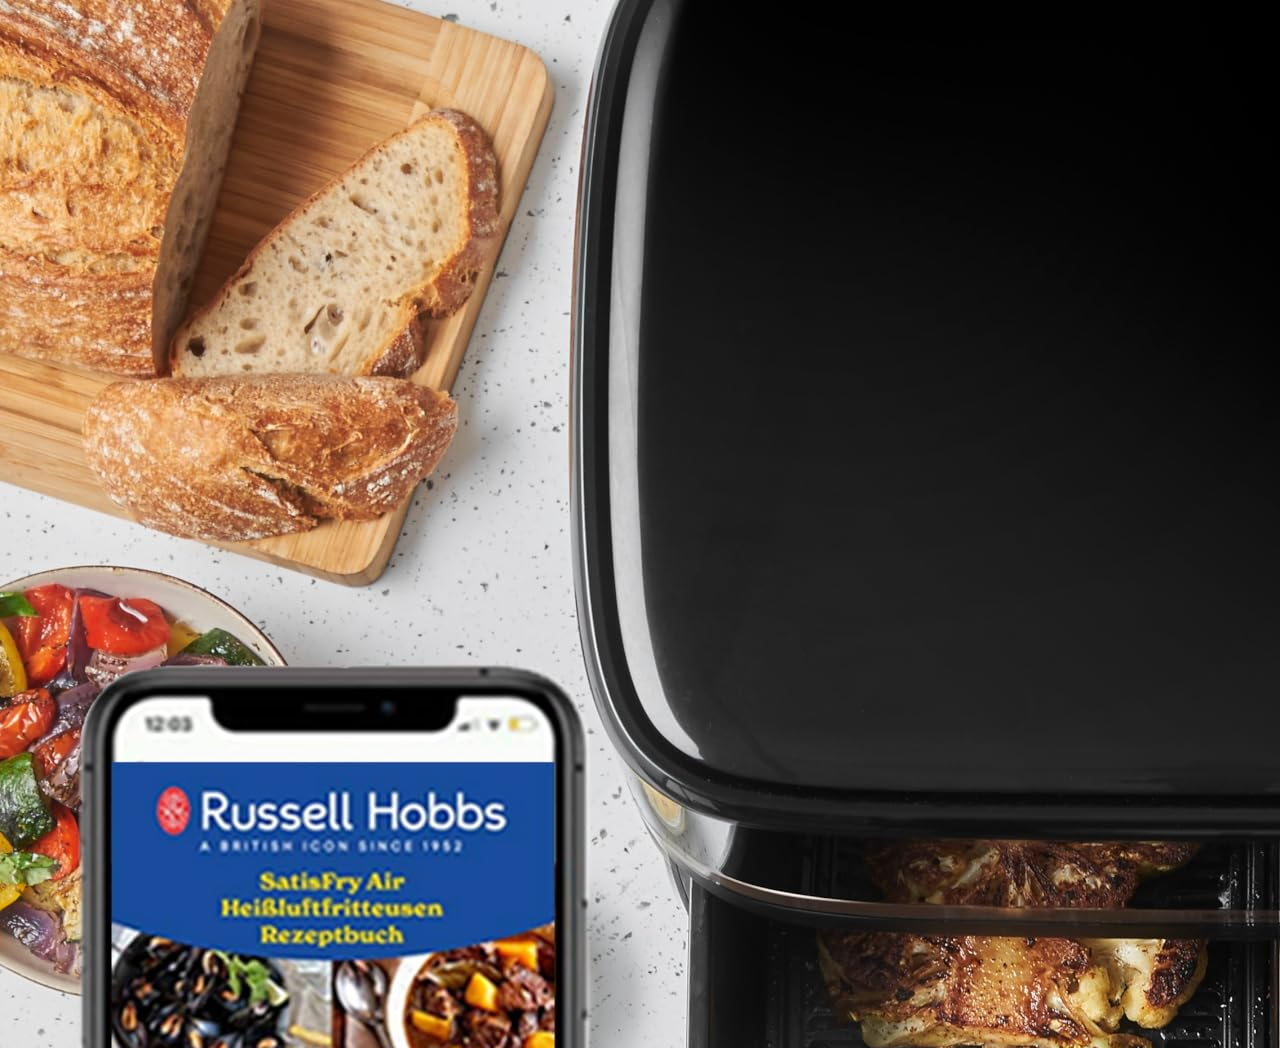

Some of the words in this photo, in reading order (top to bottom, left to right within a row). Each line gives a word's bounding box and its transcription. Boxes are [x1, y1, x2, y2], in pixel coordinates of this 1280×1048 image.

[203, 792, 352, 830] Russell
[369, 792, 506, 830] Hobbs
[200, 841, 210, 851] A
[220, 840, 292, 852] BRITISH
[302, 840, 348, 852] ICON
[358, 840, 412, 852] SINCE
[423, 840, 462, 852] 1952
[260, 872, 361, 894] SatisFry
[366, 872, 405, 890] Air
[221, 897, 443, 917] Heißluftfritteusen
[261, 925, 403, 947] Rezeptbuch
